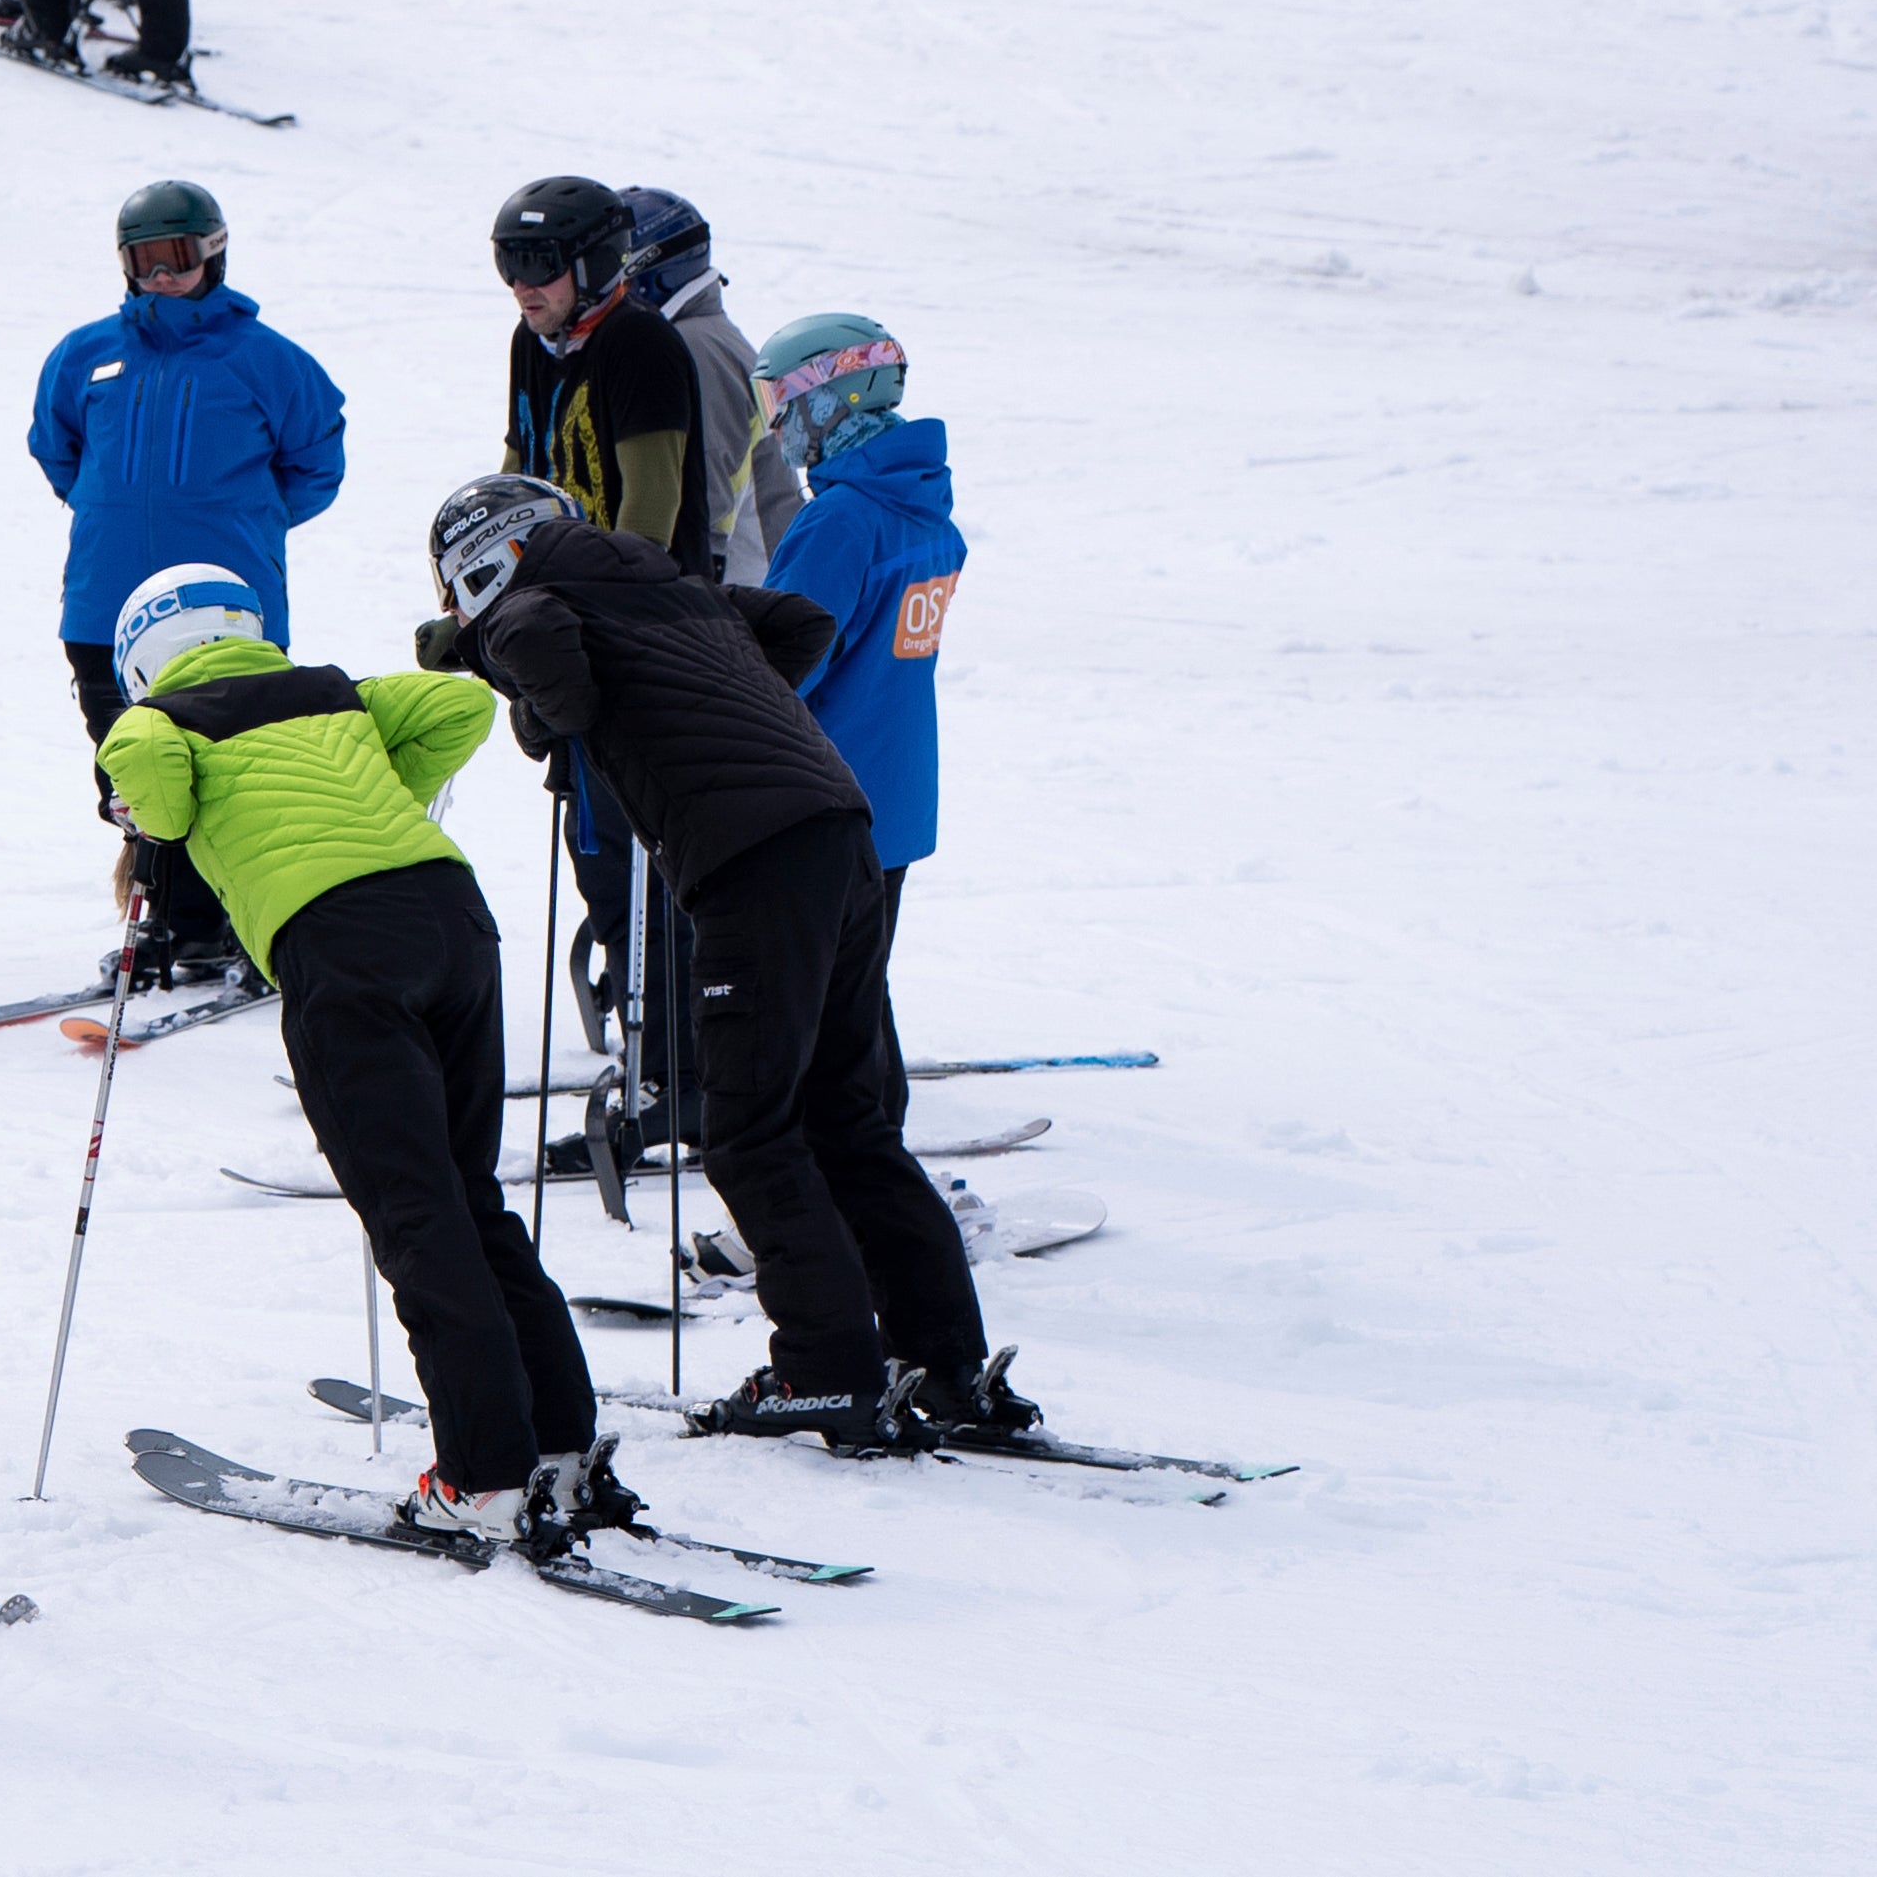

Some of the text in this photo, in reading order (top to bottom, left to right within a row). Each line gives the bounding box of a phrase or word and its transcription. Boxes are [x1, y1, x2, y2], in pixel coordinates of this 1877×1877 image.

[443, 506, 488, 544] BRIKO
[460, 507, 536, 560] BRIKO
[903, 637, 932, 652] Orego
[755, 1394, 853, 1415] NORDICA
